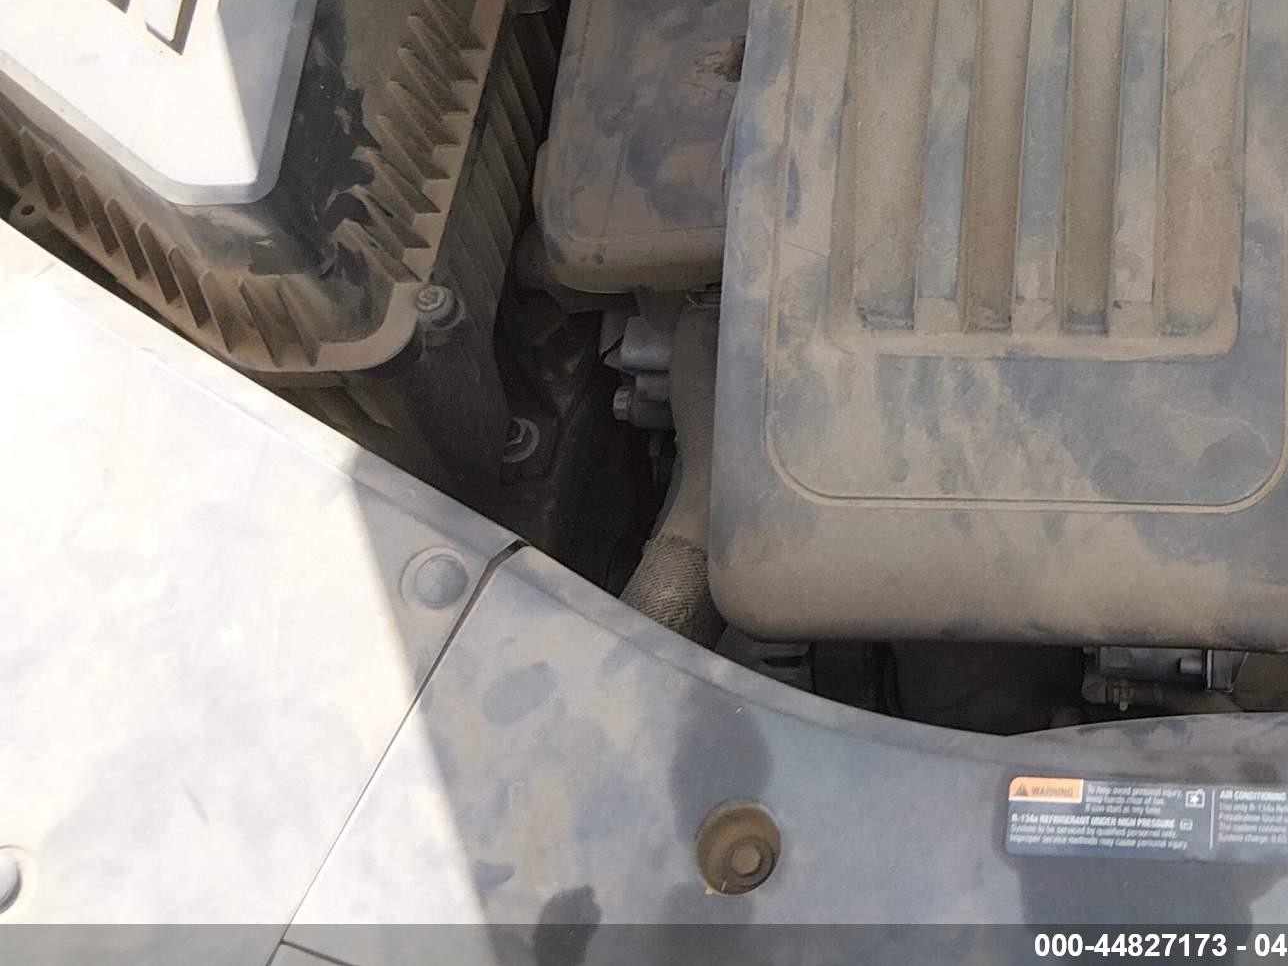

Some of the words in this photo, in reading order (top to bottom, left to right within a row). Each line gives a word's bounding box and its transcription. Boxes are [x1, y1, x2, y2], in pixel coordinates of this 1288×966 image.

[1031, 786, 1073, 796] WARNING
[1219, 790, 1233, 799] AIR
[1234, 791, 1286, 801] CONDITIONING
[1039, 814, 1089, 825] REFRIGERANT
[1091, 816, 1116, 827] UNDER
[1118, 817, 1136, 827] HIGH
[1137, 818, 1175, 828] PRESSURE
